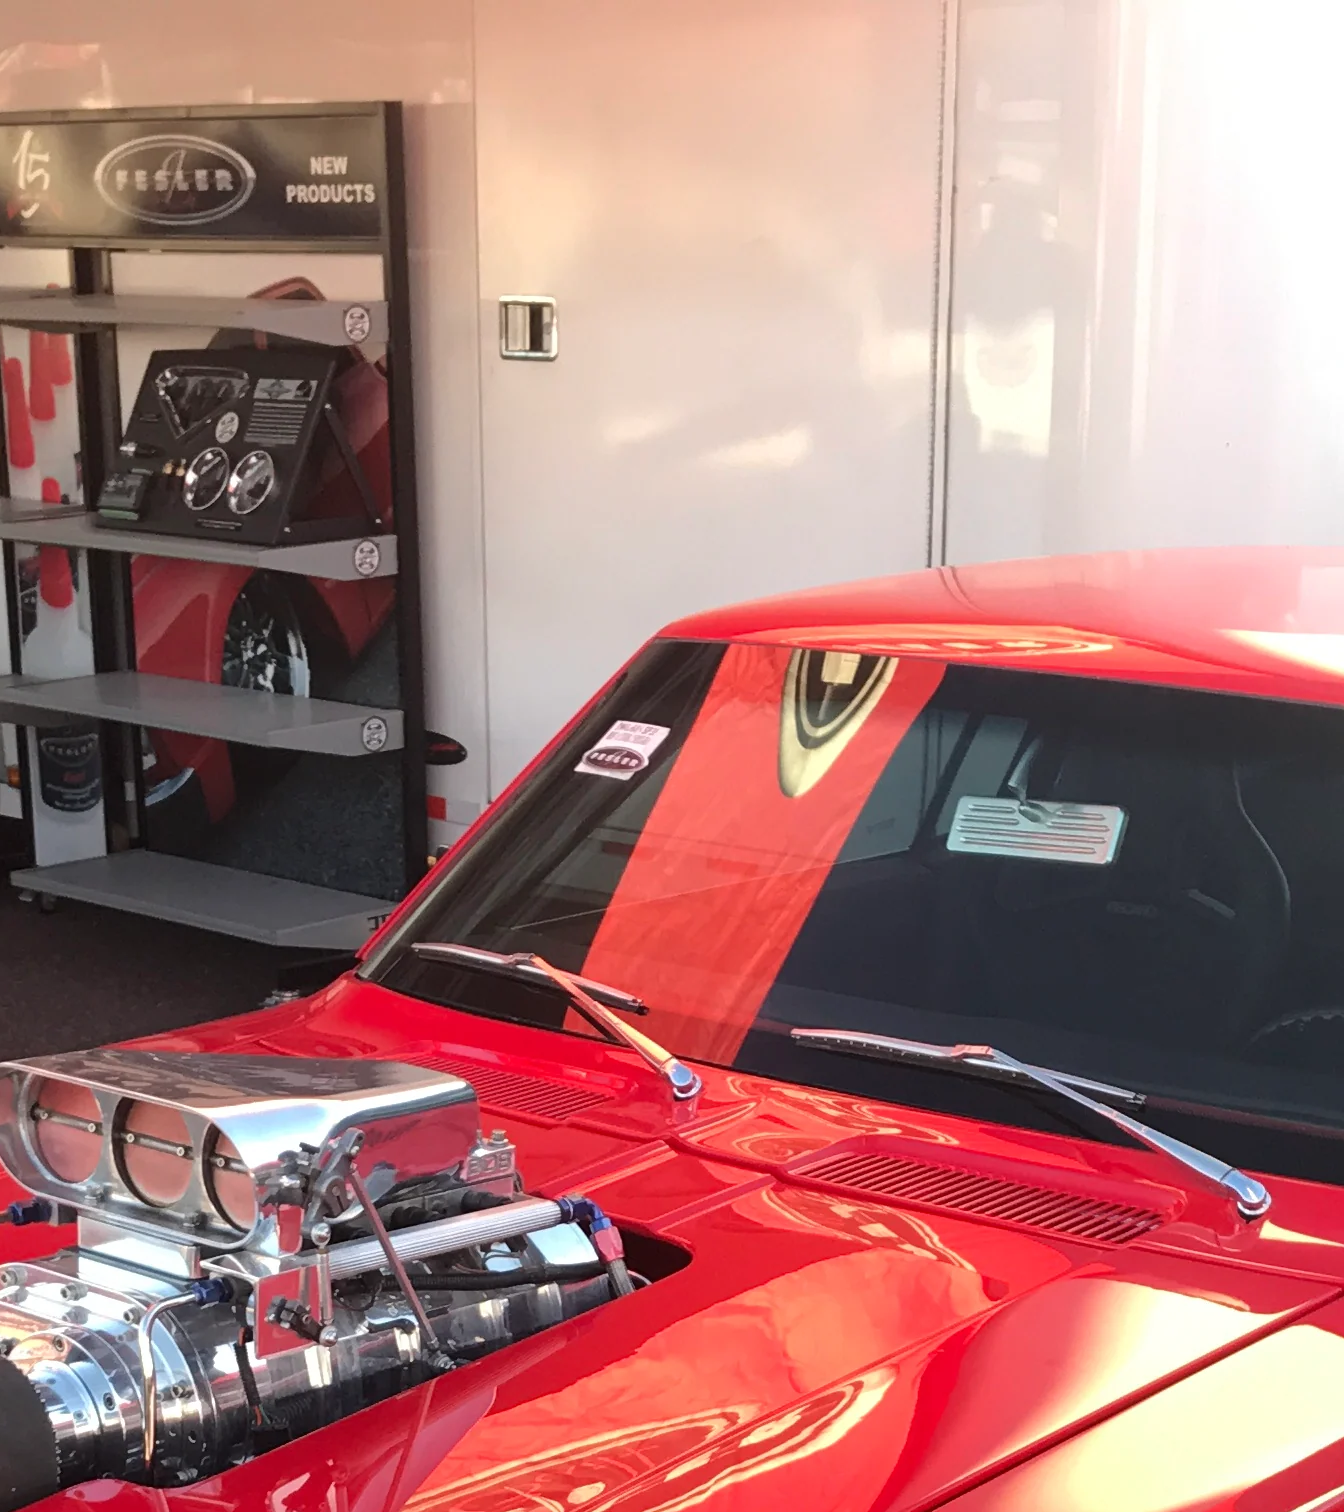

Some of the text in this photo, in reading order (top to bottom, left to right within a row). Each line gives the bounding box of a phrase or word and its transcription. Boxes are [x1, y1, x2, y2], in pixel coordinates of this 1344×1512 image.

[309, 155, 348, 175] NEW
[115, 168, 234, 192] FESLER
[285, 183, 376, 204] PRODUCTS
